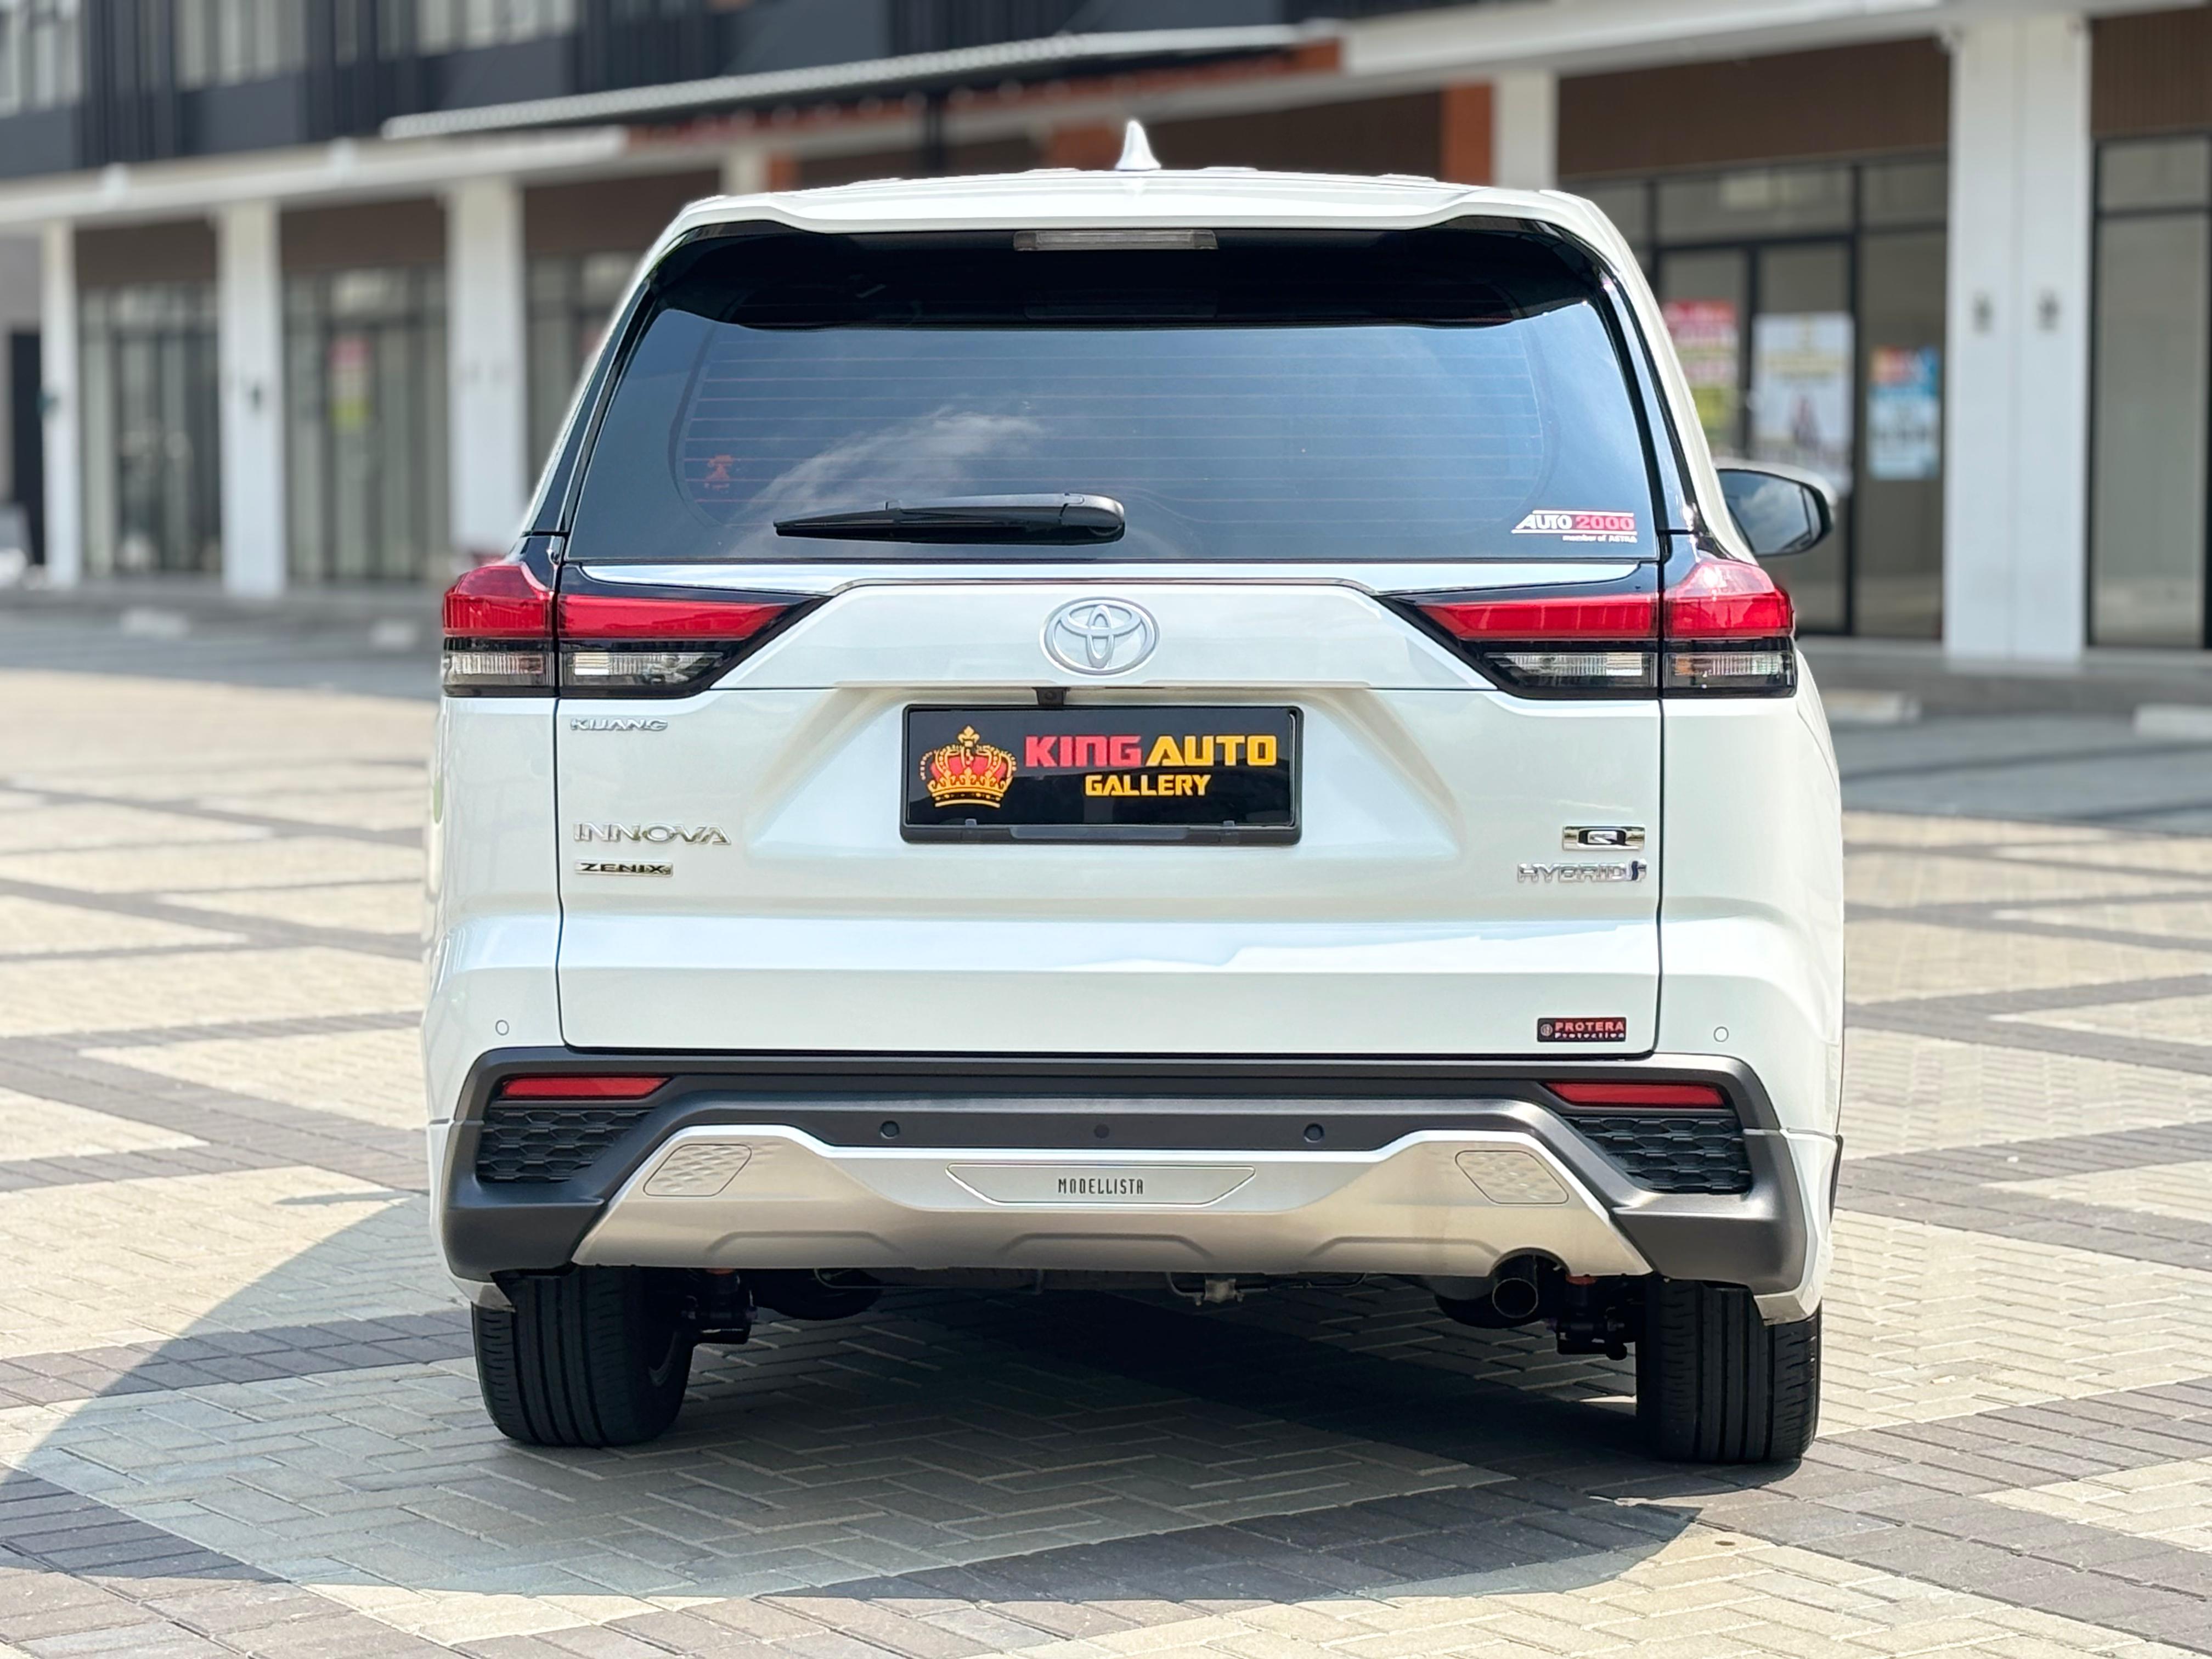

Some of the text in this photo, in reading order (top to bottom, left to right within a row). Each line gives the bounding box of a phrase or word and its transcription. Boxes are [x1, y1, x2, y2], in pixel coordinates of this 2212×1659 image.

[1515, 514, 1634, 531] AUTO 2000
[1025, 735, 1277, 767] KING AUTO
[1084, 774, 1211, 797] GALLERY
[573, 822, 732, 845] INNOVA
[580, 862, 668, 873] ZENIX
[1517, 863, 1627, 883] HYBRID
[1555, 1021, 1624, 1032] PROTERA
[1058, 1177, 1143, 1195] MODELLISTA
